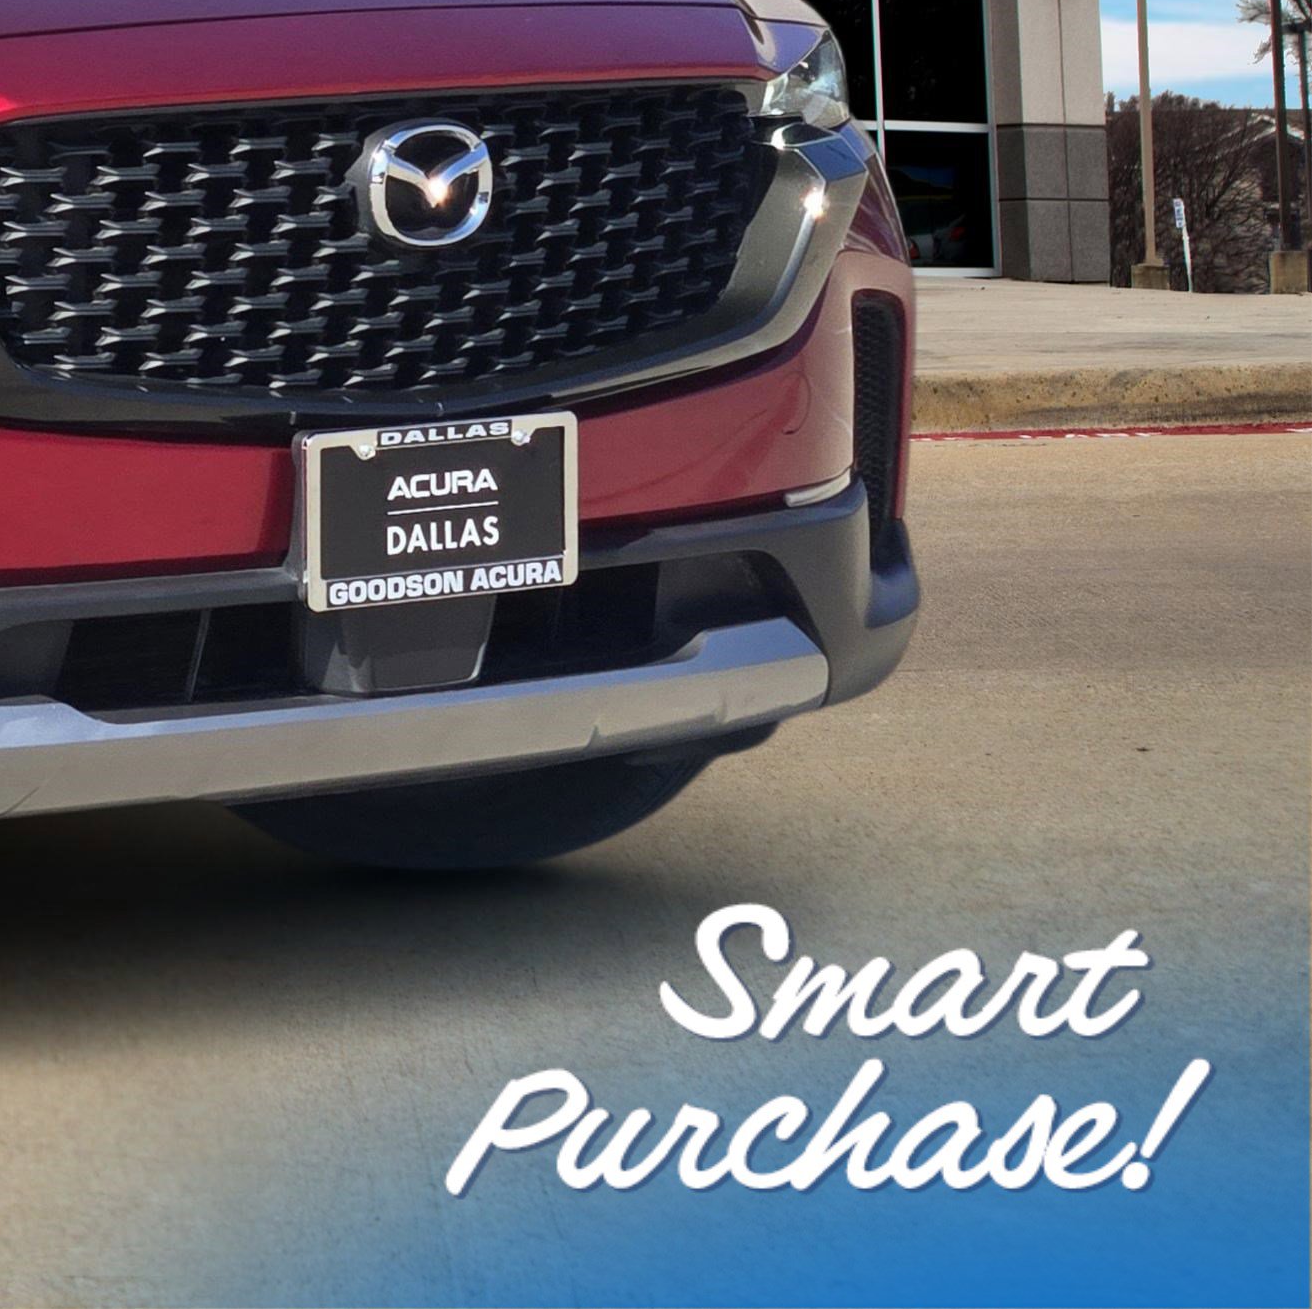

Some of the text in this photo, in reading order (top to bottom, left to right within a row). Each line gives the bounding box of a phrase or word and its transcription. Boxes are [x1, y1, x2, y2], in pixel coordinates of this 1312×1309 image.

[381, 422, 512, 445] DALLAS
[387, 468, 498, 501] ACURA
[387, 516, 499, 555] DALLAS
[329, 559, 562, 606] GOODSON ACURA
